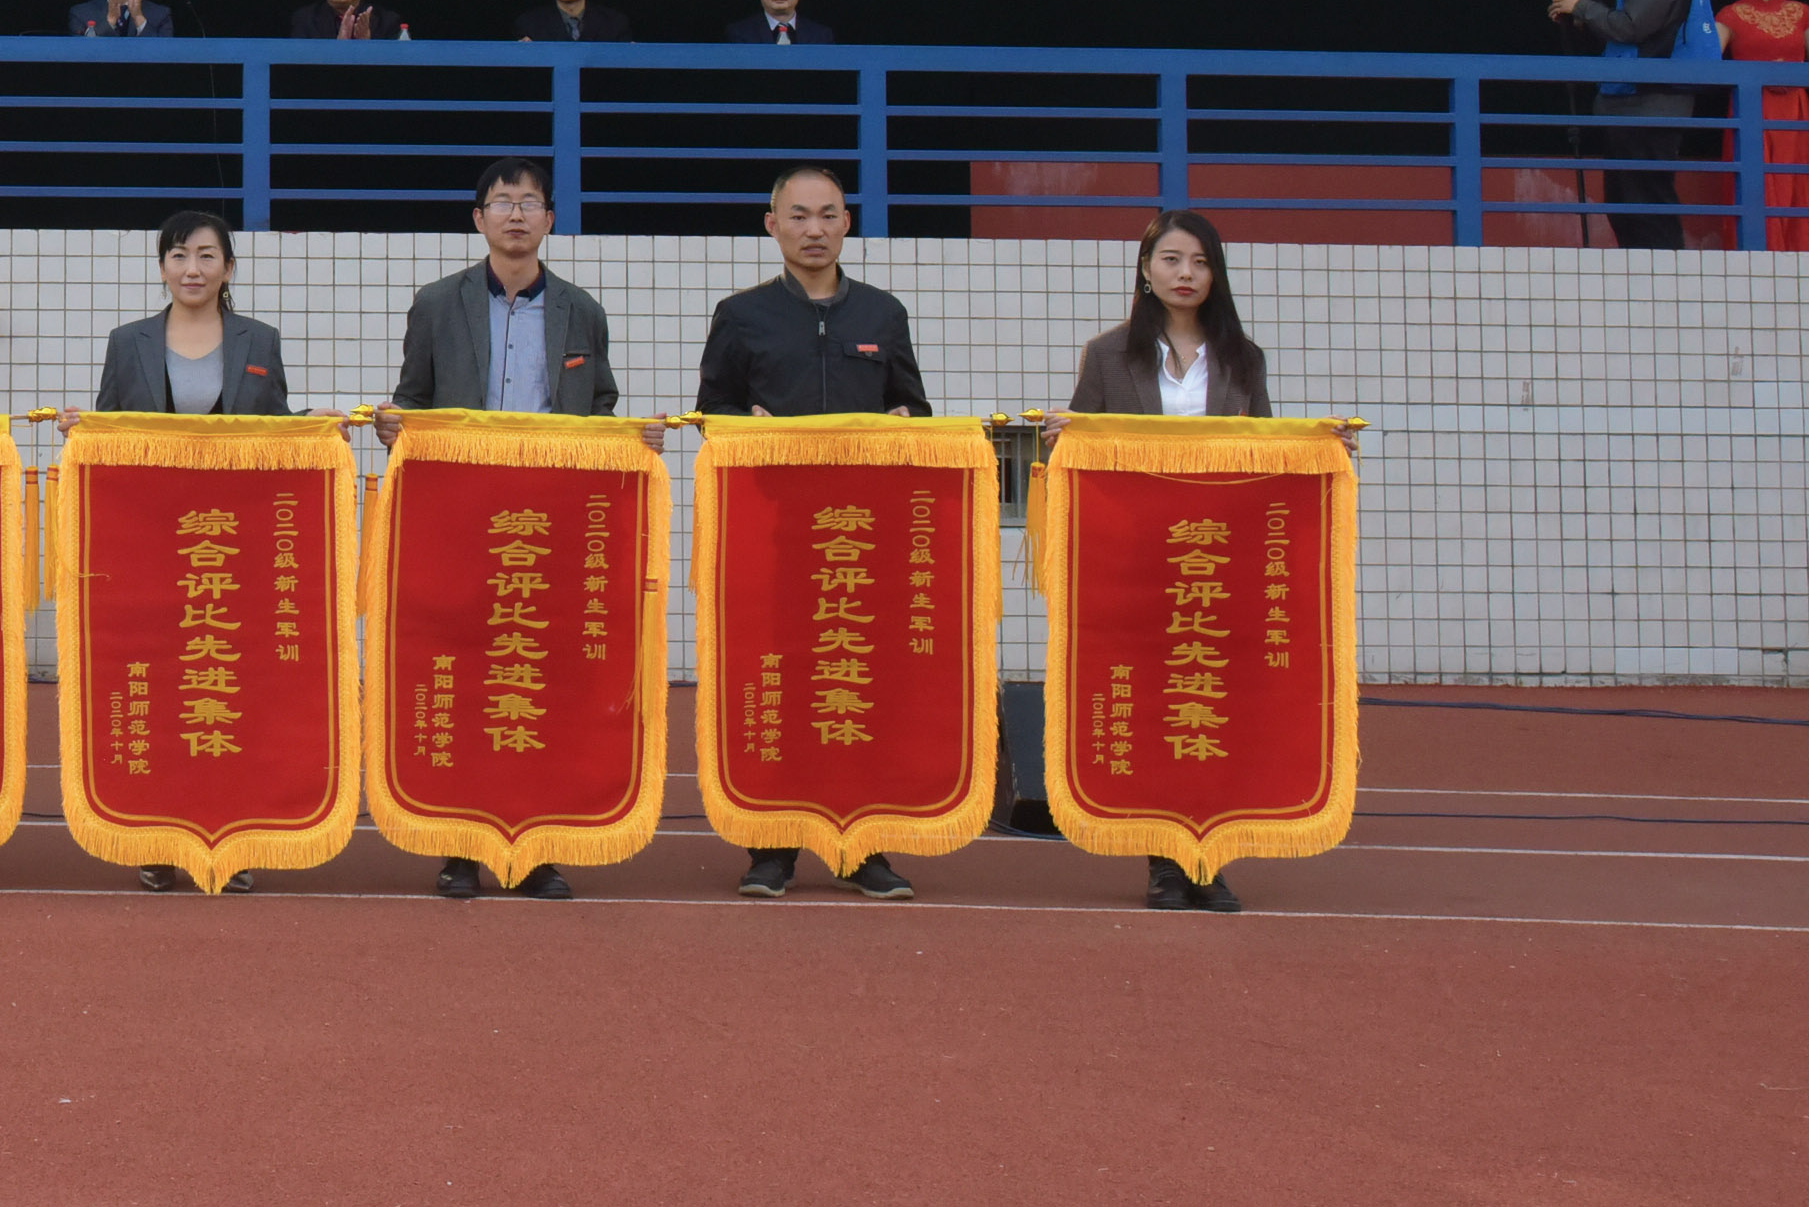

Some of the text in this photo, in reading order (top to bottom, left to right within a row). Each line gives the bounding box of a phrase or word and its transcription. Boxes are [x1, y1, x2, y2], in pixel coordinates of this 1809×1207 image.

[177, 510, 242, 757] 综合评比先进集体
[431, 655, 456, 767] 南阳师范学院
[483, 510, 552, 753] 综合评比先进集体
[760, 653, 783, 762] 南阳师范学院
[811, 505, 875, 745] 综合评比先进集体
[1163, 519, 1231, 761] 综合评比先进集体
[127, 662, 151, 774] 南阳师范学院
[1110, 664, 1133, 775] 南阳师范学院
